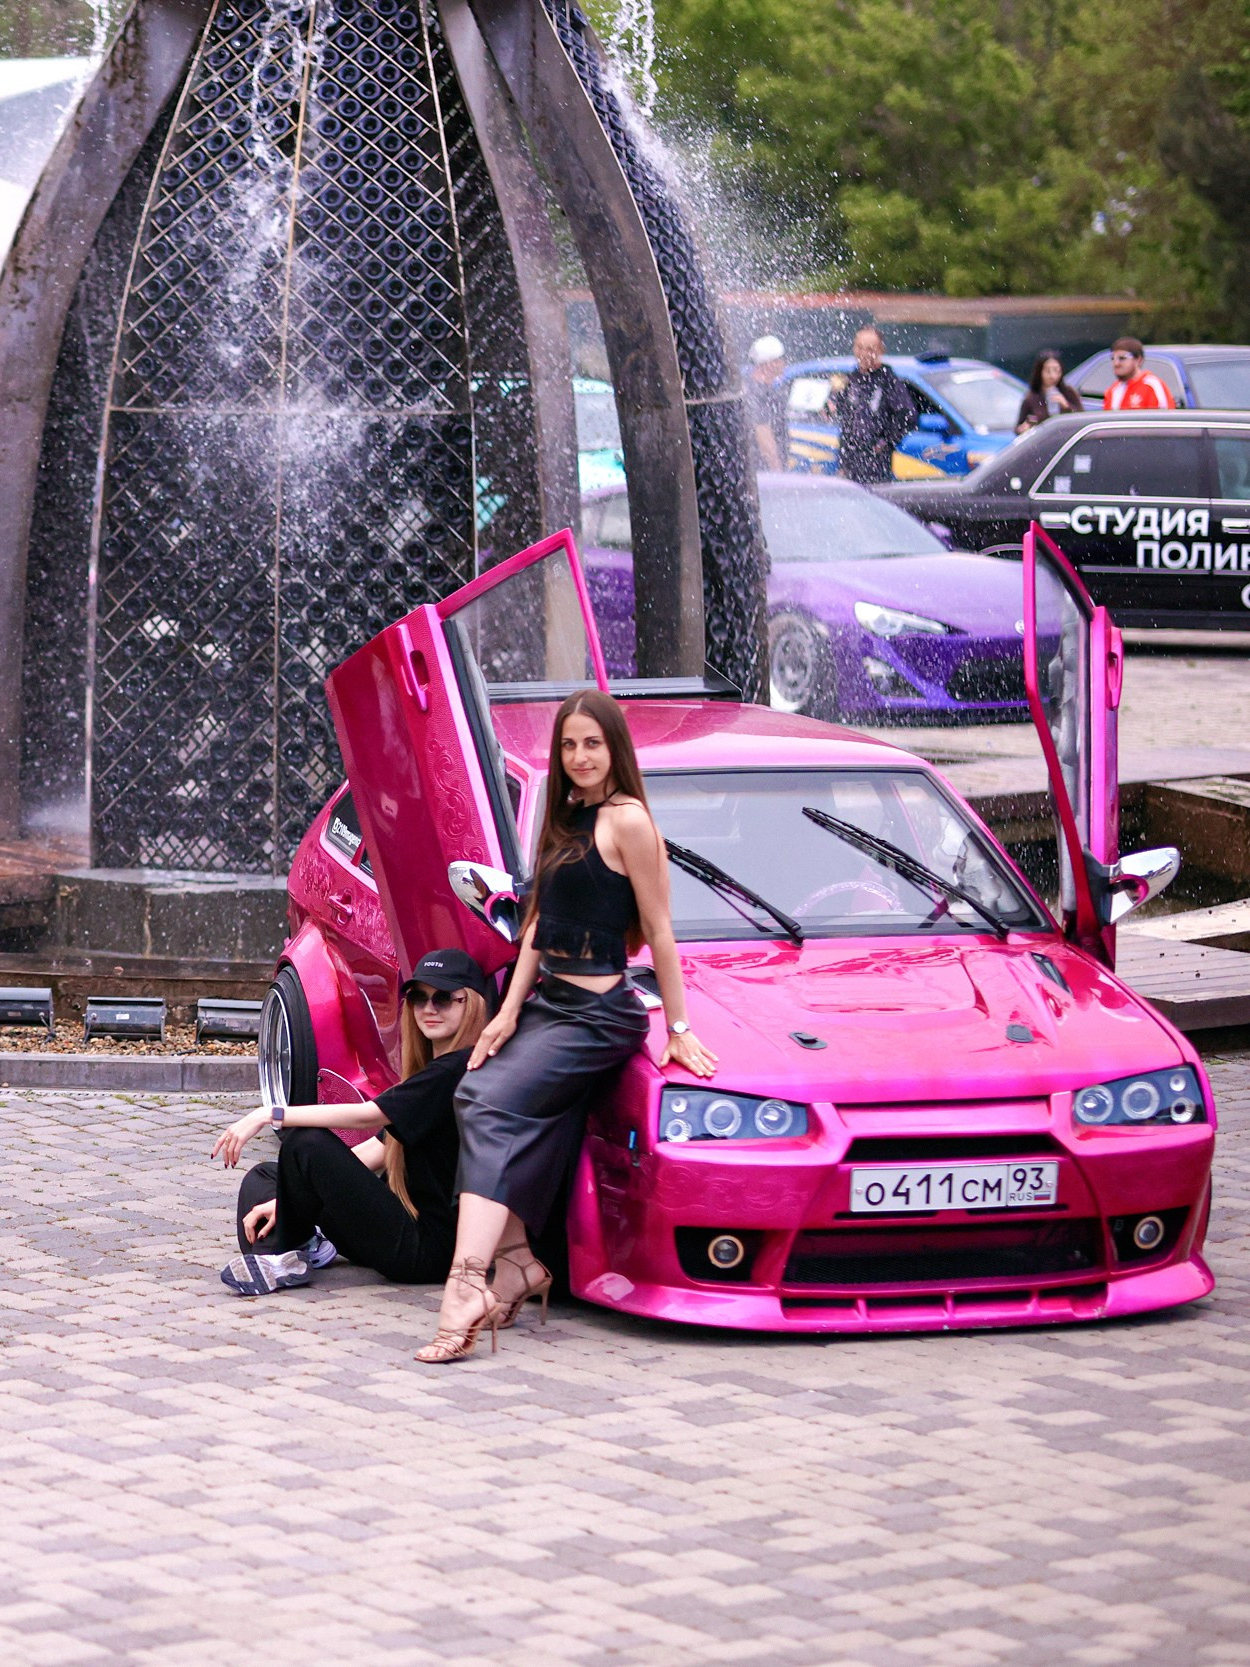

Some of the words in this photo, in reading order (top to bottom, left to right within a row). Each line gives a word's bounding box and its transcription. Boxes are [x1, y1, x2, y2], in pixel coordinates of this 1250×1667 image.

[1070, 505, 1209, 541] СТУДИЯ
[1012, 1167, 1044, 1192] 93
[1009, 1192, 1033, 1202] RUS
